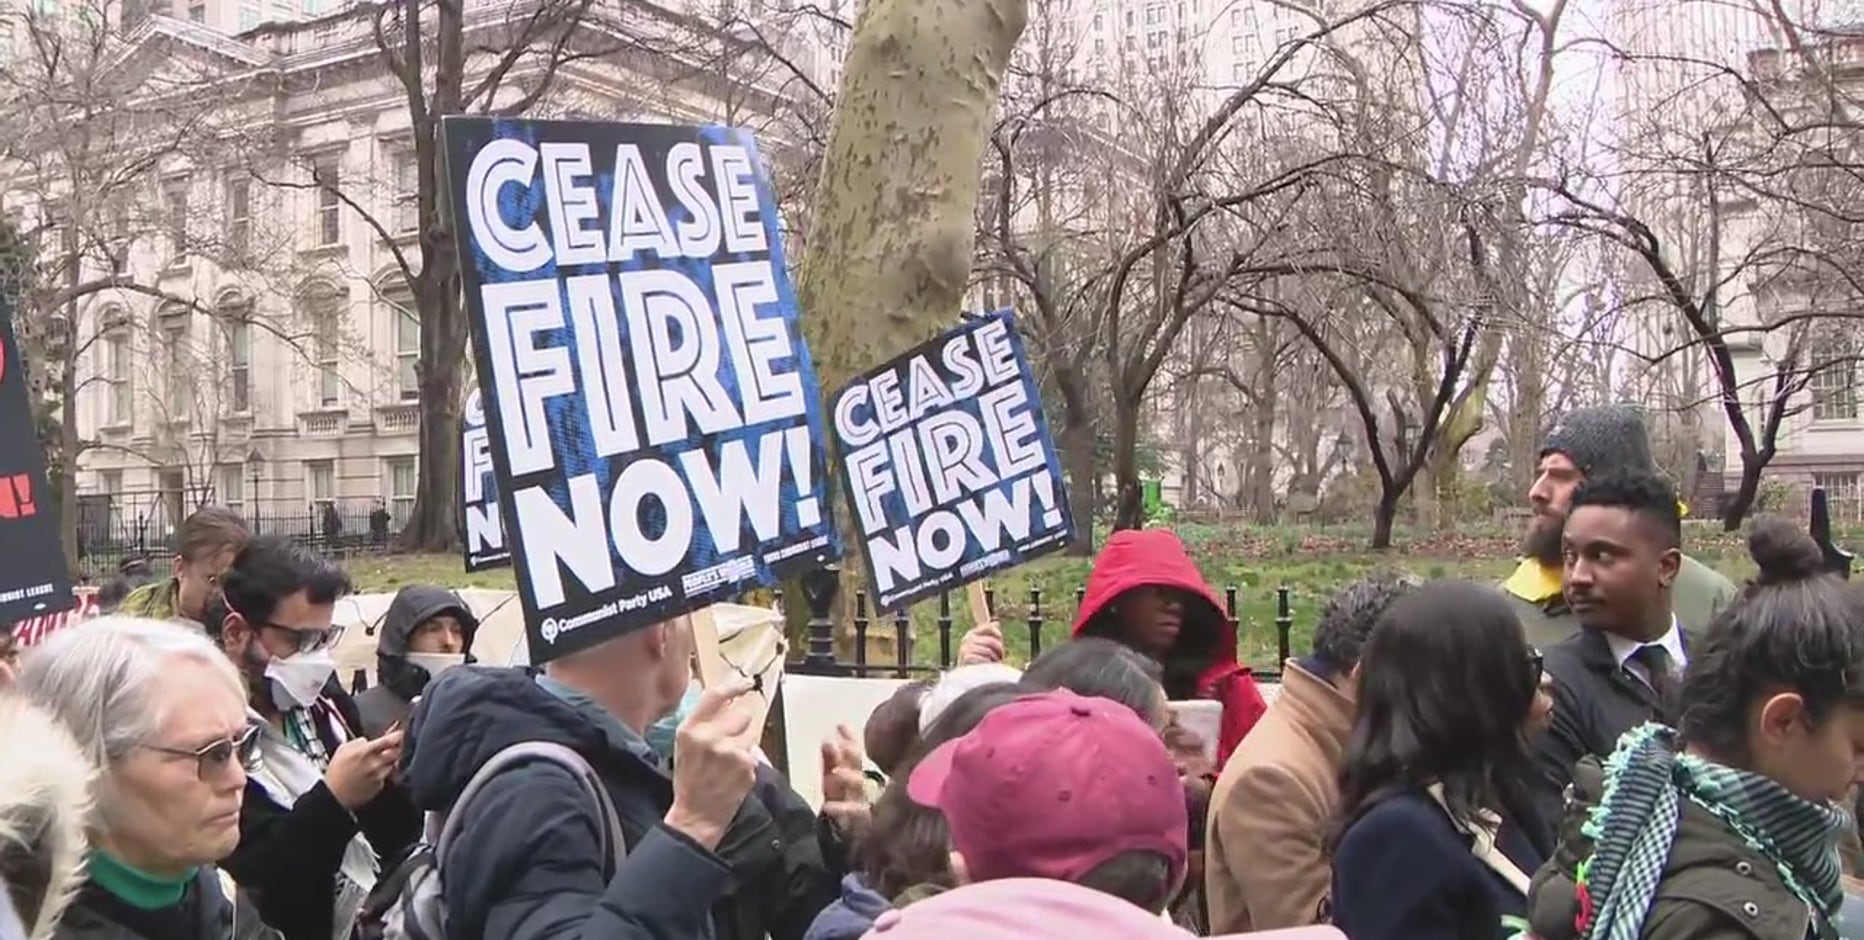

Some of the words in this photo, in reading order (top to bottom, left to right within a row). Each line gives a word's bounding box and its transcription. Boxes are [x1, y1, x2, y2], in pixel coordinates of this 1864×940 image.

[466, 138, 768, 272] CEASE
[481, 261, 806, 477] FIRE
[835, 318, 1021, 446] CEASE
[513, 425, 821, 610] NOW!
[845, 379, 1047, 536] FIRE
[868, 469, 1063, 593] NOW!
[559, 602, 618, 632] Communist
[618, 594, 647, 612] Party
[648, 585, 673, 602] USA
